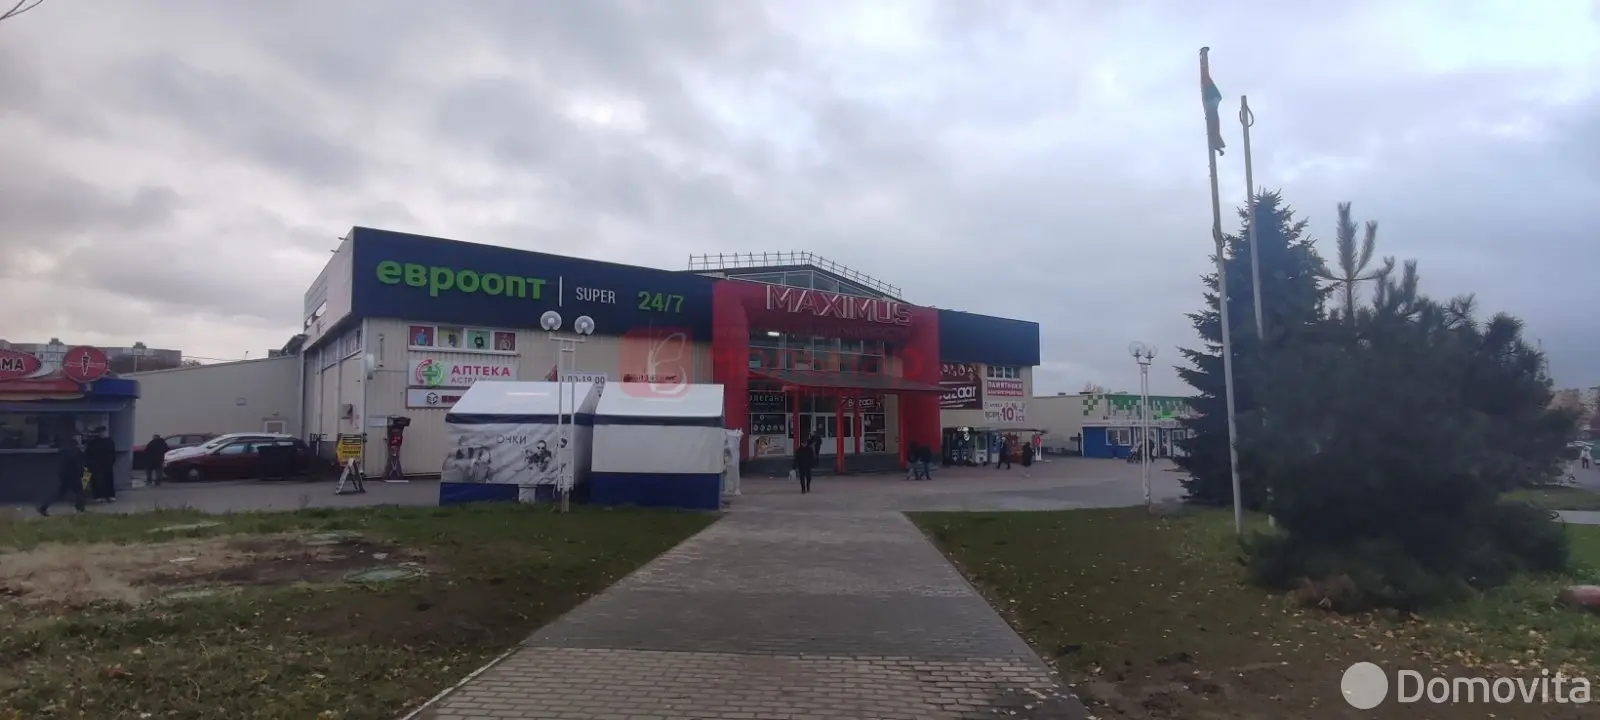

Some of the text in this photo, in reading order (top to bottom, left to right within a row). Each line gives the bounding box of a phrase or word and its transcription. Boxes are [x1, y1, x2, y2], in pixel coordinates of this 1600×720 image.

[376, 260, 546, 300] евроопт
[576, 286, 616, 305] SUPER
[637, 291, 684, 314] 24/7
[765, 284, 913, 327] MAXIMUS
[0, 357, 25, 371] МА
[451, 365, 511, 377] АПТЕКА
[939, 386, 976, 399] azaar
[497, 434, 527, 445] ОЧКИ
